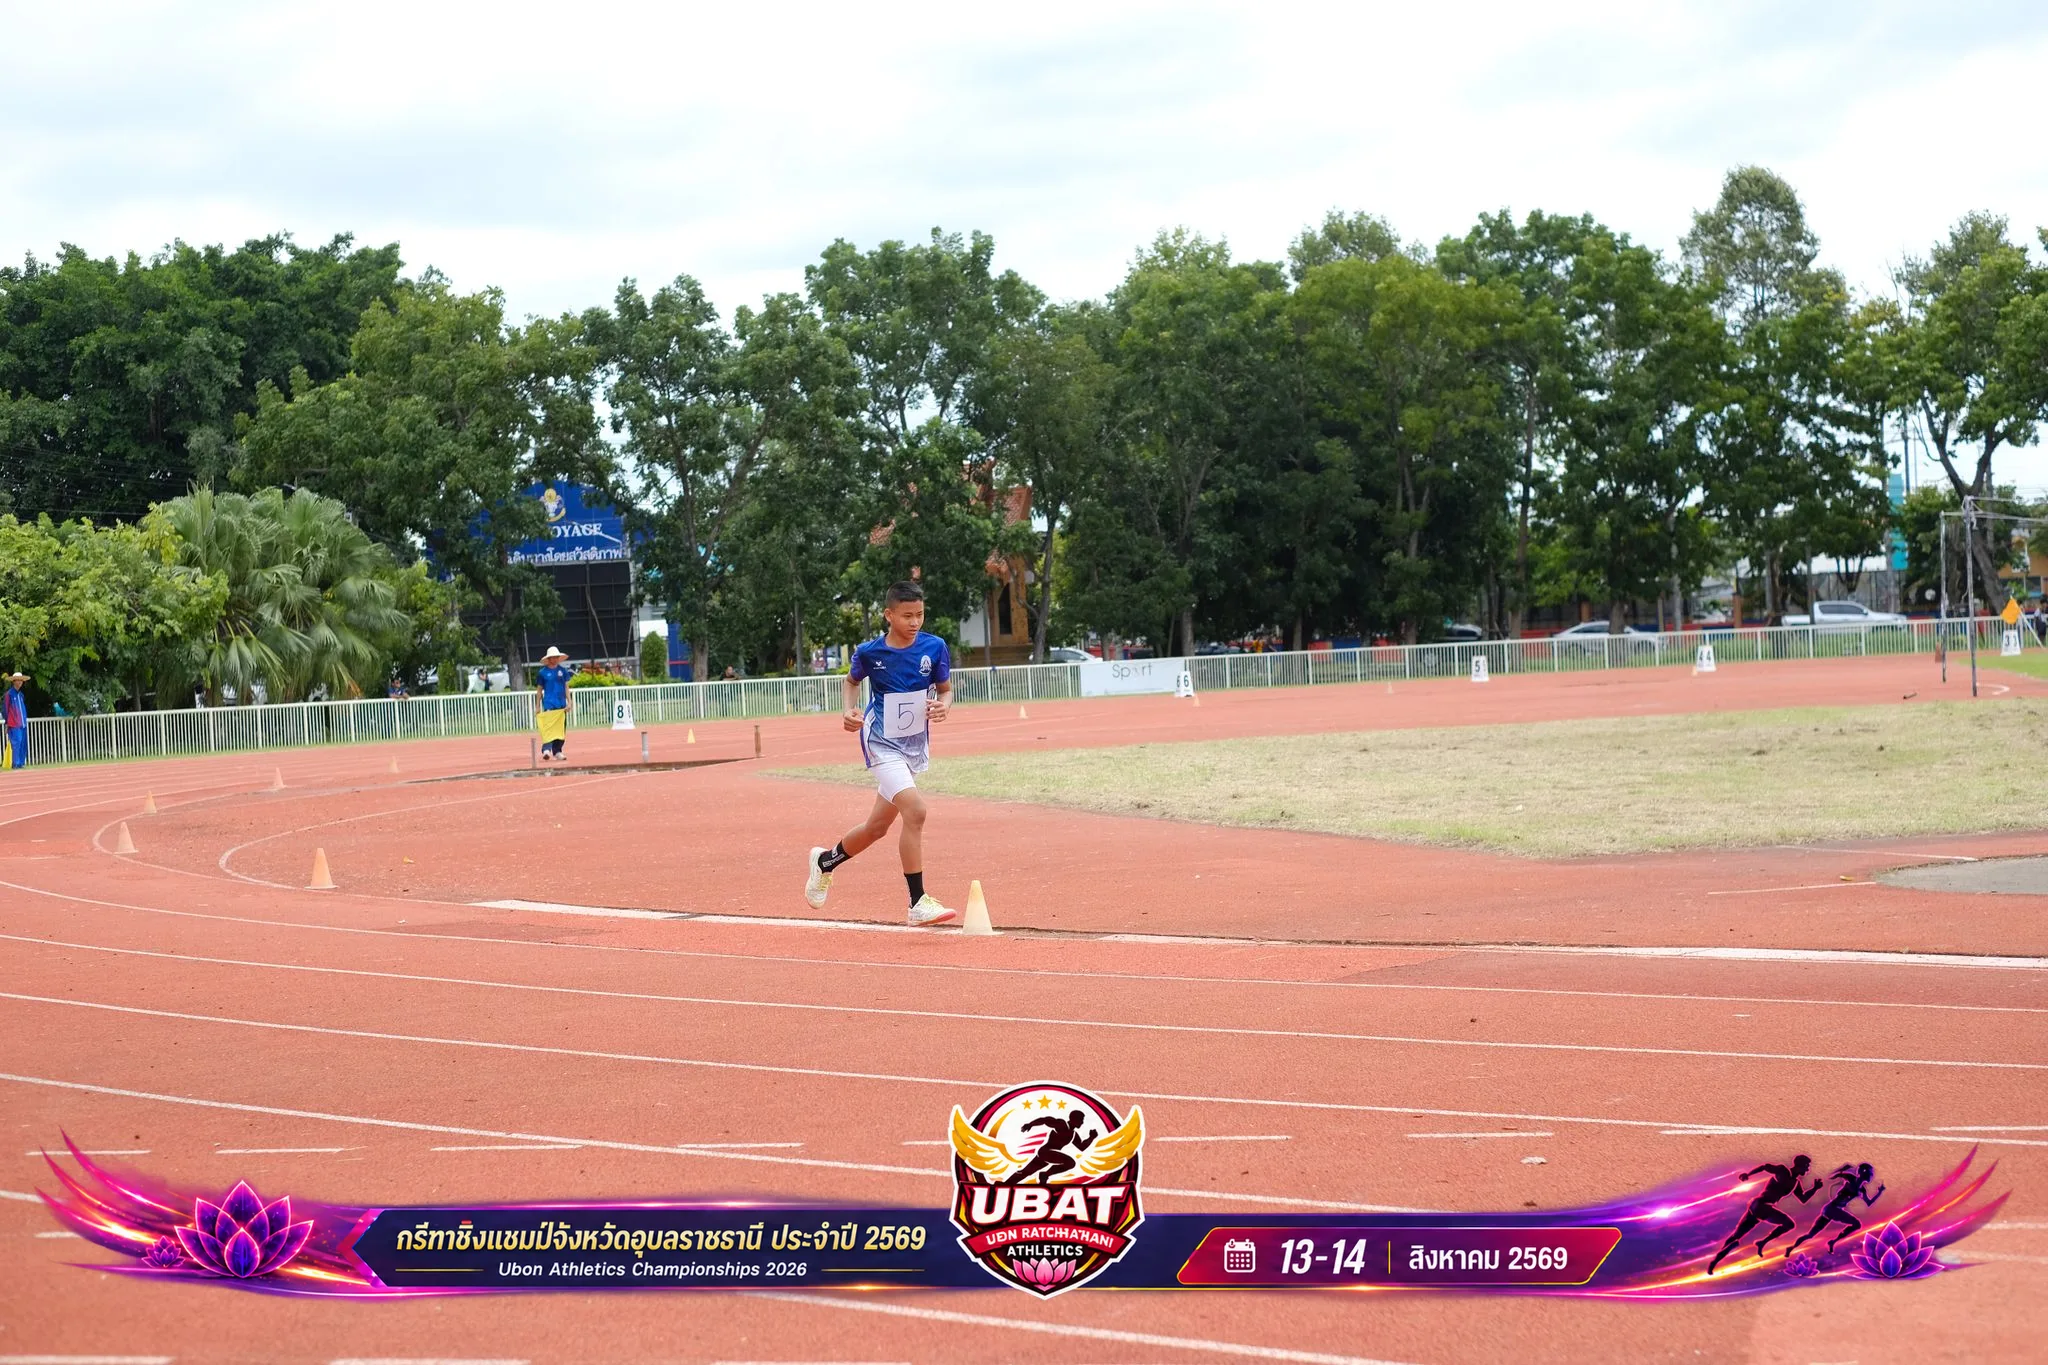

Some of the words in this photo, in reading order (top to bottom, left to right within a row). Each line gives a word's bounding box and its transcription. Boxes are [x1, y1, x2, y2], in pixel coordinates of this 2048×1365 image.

[1475, 660, 1480, 672] 5
[1184, 675, 1189, 687] 6
[617, 705, 624, 718] 8
[897, 702, 914, 731] 5
